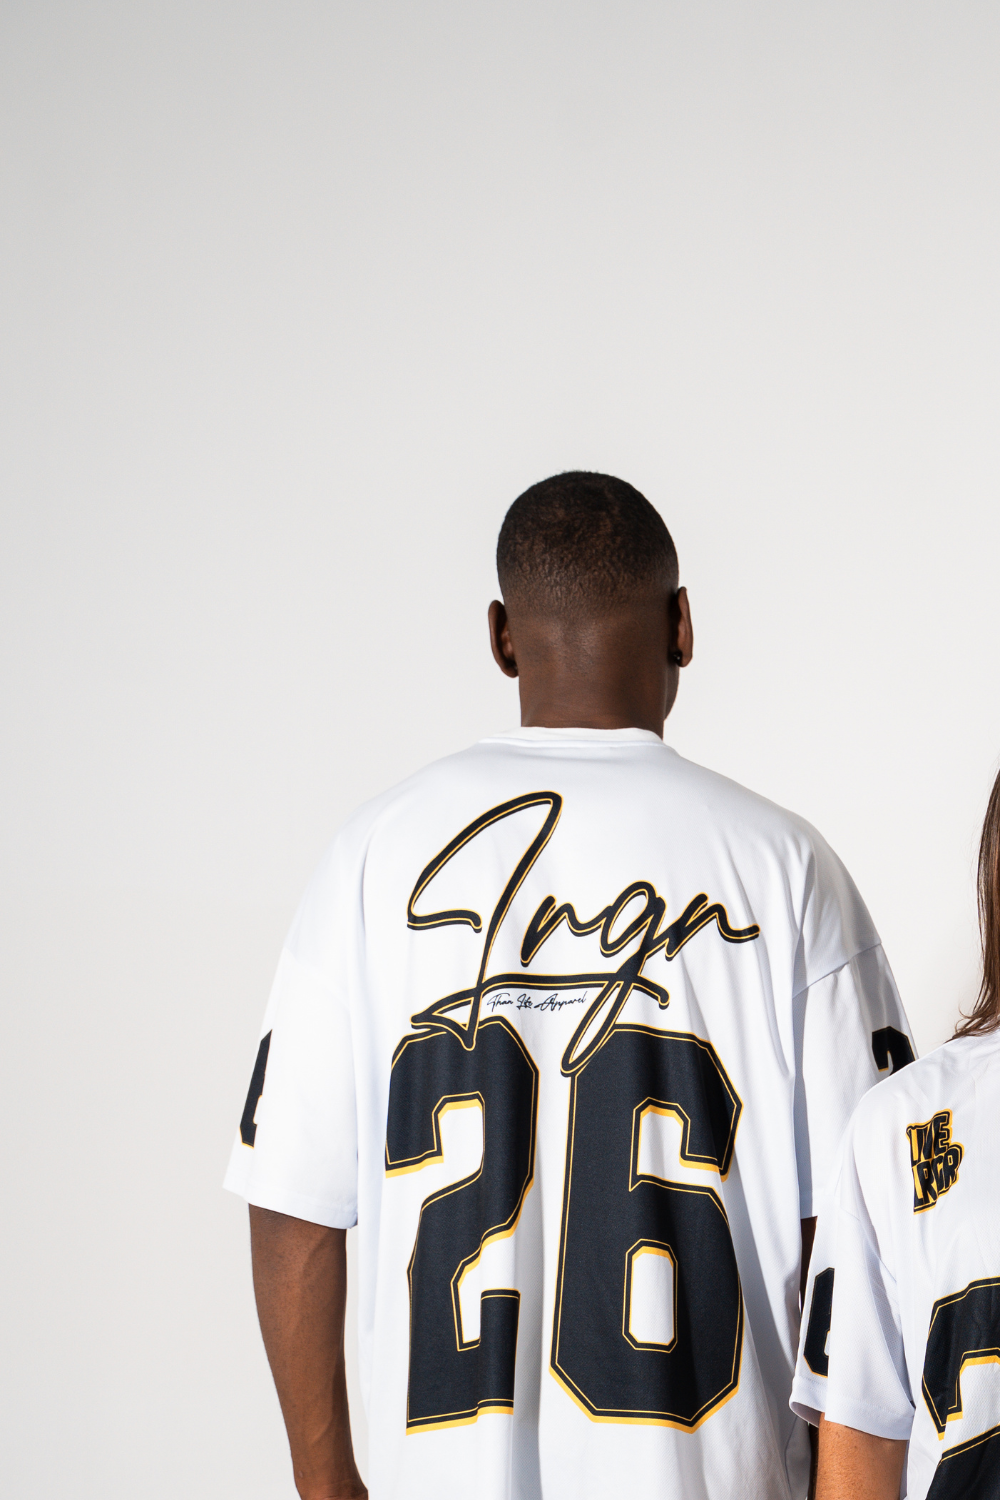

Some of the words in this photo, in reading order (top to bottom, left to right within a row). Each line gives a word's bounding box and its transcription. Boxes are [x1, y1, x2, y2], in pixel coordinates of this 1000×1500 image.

[487, 992, 514, 1012] Than
[533, 991, 588, 1011] Apparel
[385, 1014, 744, 1435] 26
